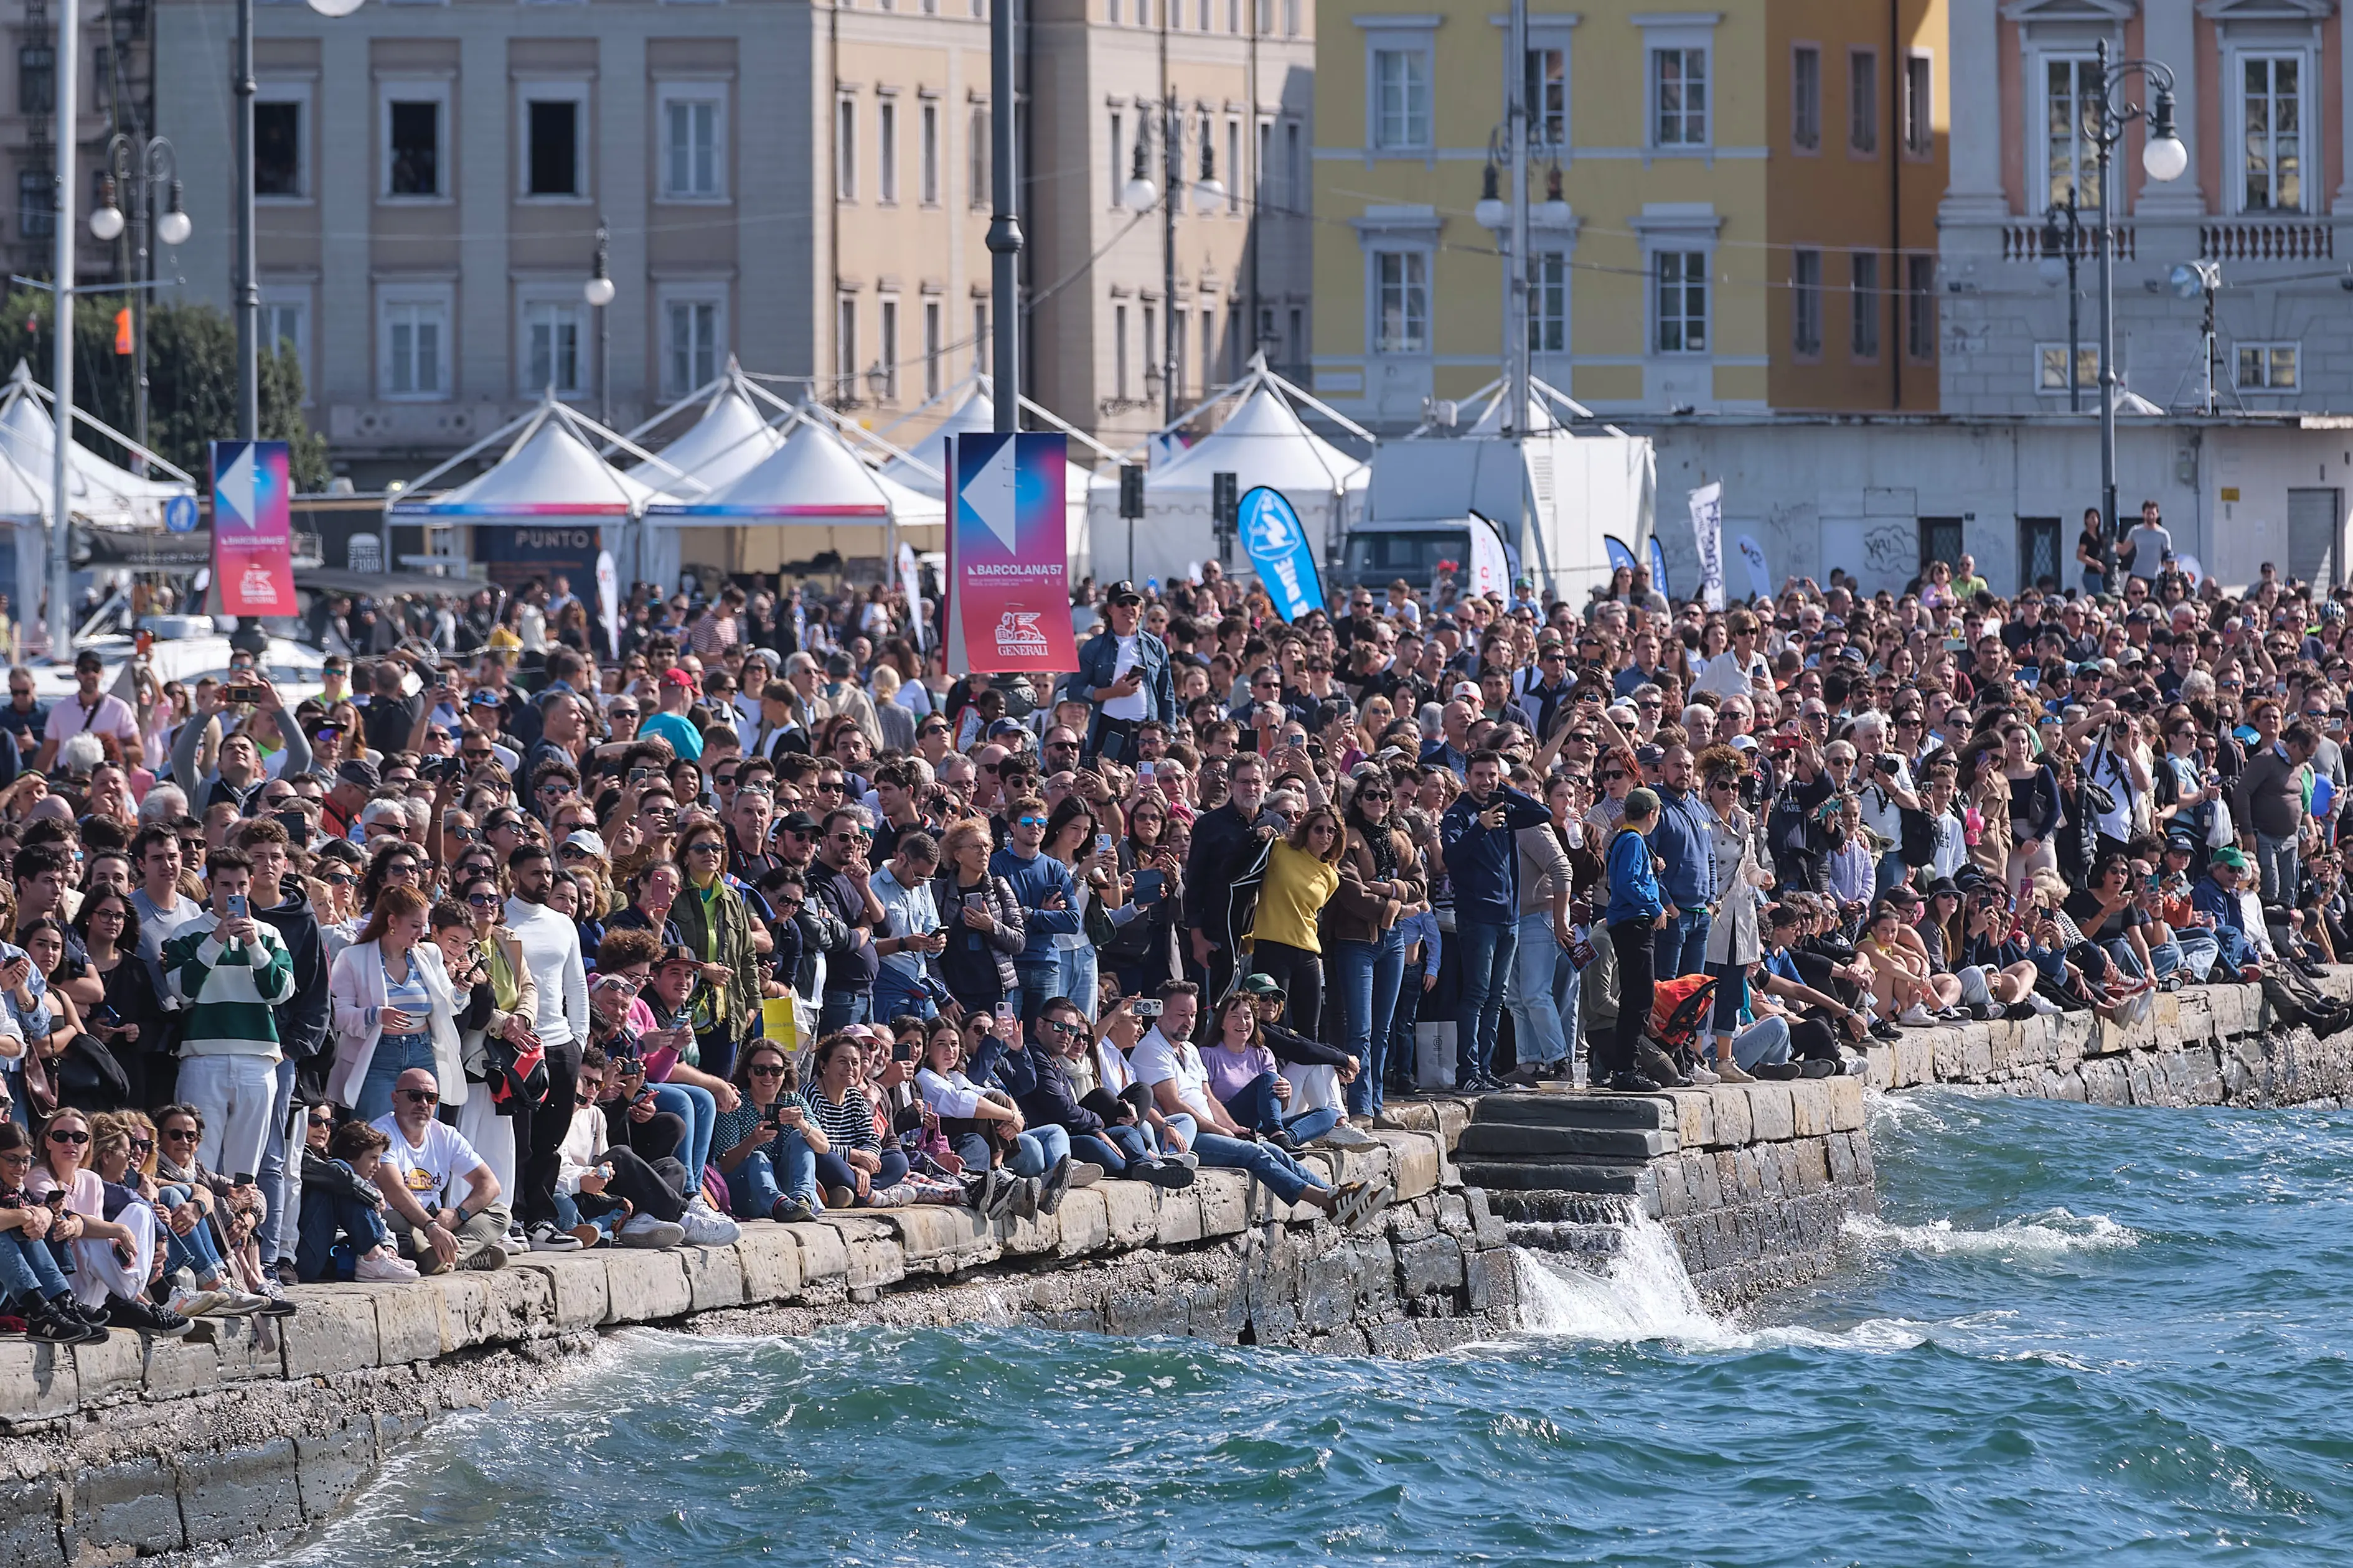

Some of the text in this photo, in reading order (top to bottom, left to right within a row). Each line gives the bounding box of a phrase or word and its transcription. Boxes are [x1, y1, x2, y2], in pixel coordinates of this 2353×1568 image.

[515, 530, 589, 548] PUNTO
[997, 645, 1049, 656] GENERALI
[420, 1171, 442, 1188] Rock
[41, 1323, 57, 1337] N
